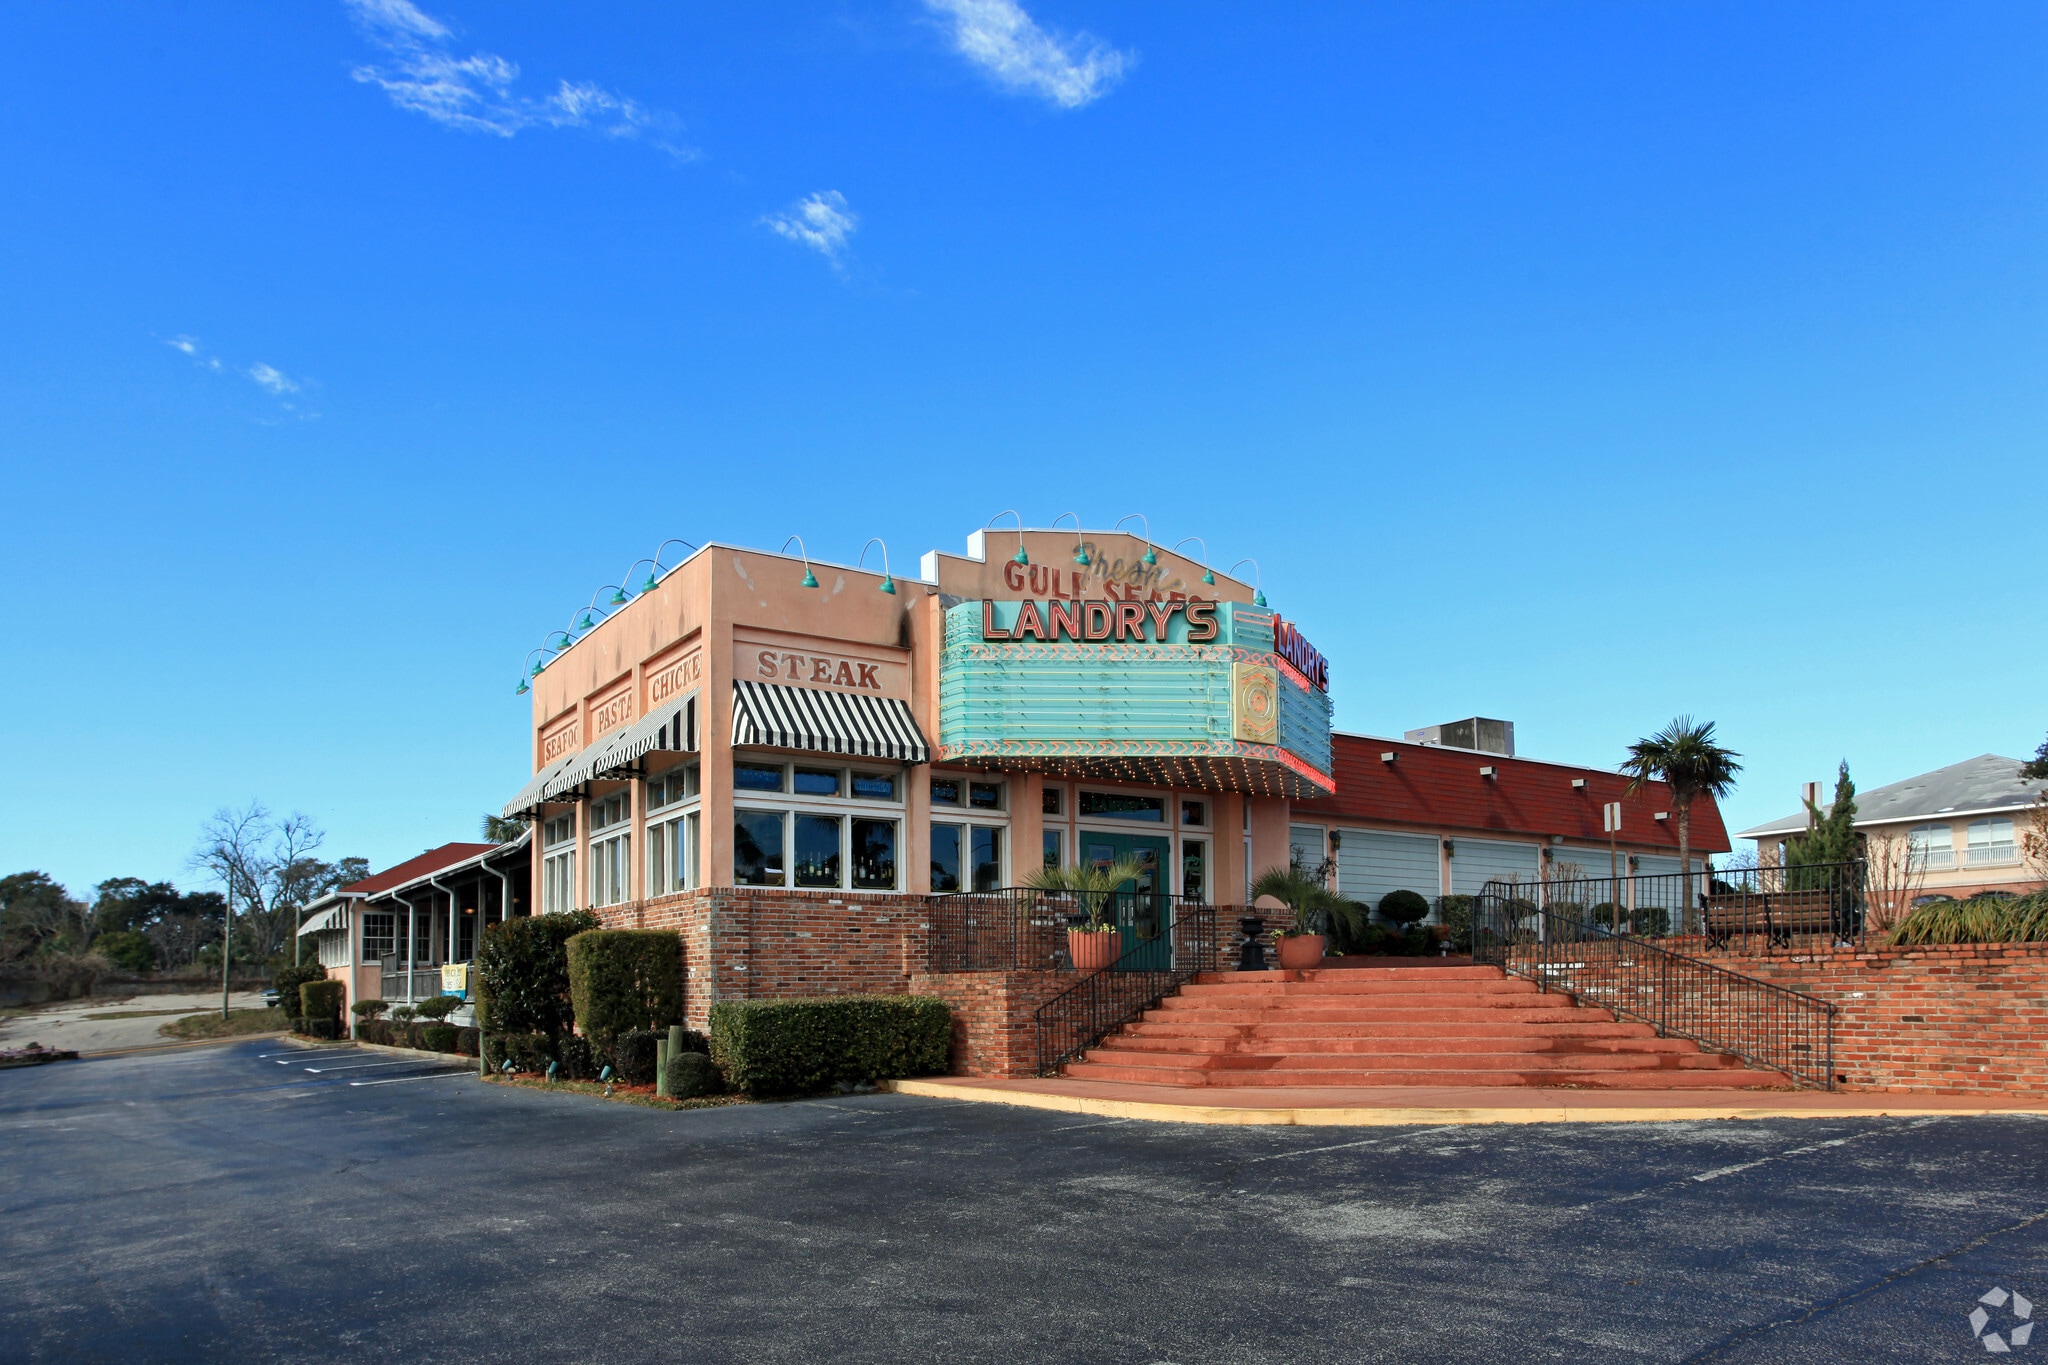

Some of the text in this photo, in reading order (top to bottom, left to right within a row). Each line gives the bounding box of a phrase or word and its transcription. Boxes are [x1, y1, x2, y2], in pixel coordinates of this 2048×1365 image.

[983, 598, 1220, 641] LANDRY'S
[758, 650, 881, 690] STEAK
[1274, 613, 1329, 694] LANDRY'S
[652, 655, 702, 703] CHICKE
[598, 692, 632, 733] PASTA
